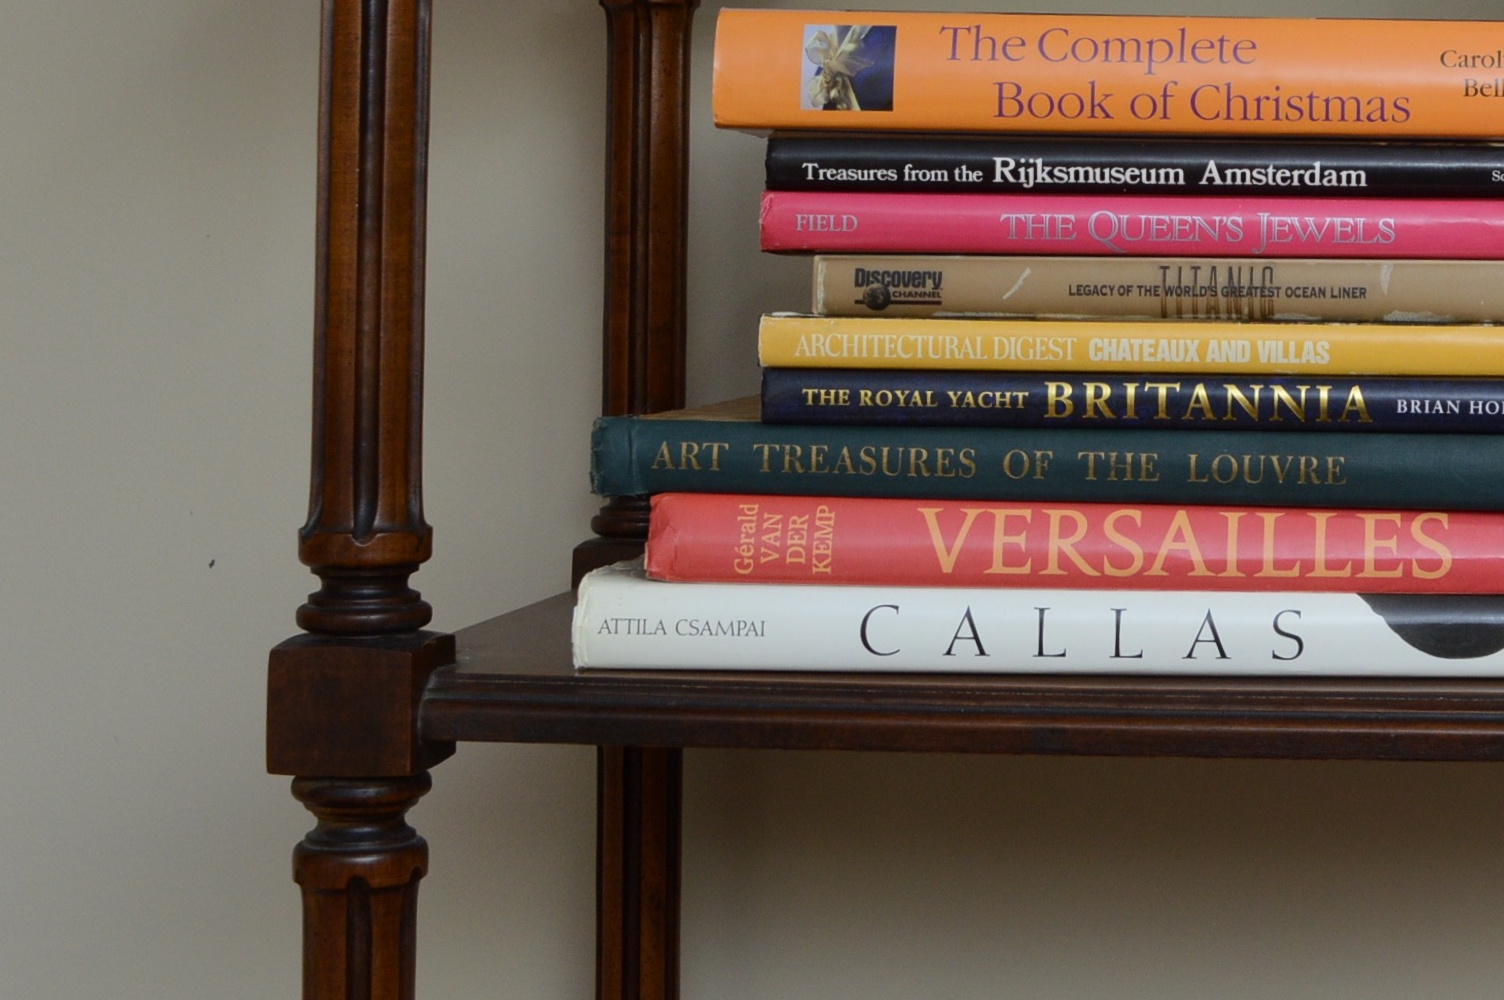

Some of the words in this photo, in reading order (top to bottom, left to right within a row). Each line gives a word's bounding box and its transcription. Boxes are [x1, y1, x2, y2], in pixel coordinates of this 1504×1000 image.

[940, 26, 1026, 62] The
[1037, 27, 1257, 75] Complete
[993, 81, 1114, 120] Book
[1130, 81, 1178, 121] of
[1190, 83, 1411, 123] Christmas
[802, 163, 898, 182] Treasures
[903, 165, 949, 183] from
[953, 166, 984, 183] the
[992, 157, 1185, 188] Rijksmuseum
[1199, 160, 1368, 188] Amsterdam
[795, 213, 858, 233] FIELD
[1001, 213, 1077, 241] THE
[1088, 210, 1243, 253] QUEEN'S
[1254, 211, 1396, 252] JEWELS
[892, 290, 943, 299] CHANNEL
[1068, 283, 1114, 297] LEGACY
[1117, 284, 1133, 297] OF
[1136, 284, 1160, 298] THE
[1165, 285, 1218, 298] WORLD'S
[1221, 286, 1282, 299] GREATEST
[1285, 286, 1328, 299] OCEAN
[1330, 286, 1367, 299] LINER
[1160, 265, 1275, 319] TITANIC
[795, 334, 987, 360] ARCHITECTURAL
[993, 337, 1077, 361] DIGEST
[1089, 337, 1200, 363] CHATEAUX
[1206, 339, 1251, 363] AND
[1257, 340, 1330, 364] VILLAS
[802, 388, 850, 407] THE
[859, 389, 938, 408] ROYAL
[947, 391, 1029, 410] YACHT
[1044, 380, 1373, 424] BRITANNIA
[1396, 399, 1461, 415] BRIAN
[652, 441, 729, 471] ART
[753, 443, 977, 478] TREASURES
[1003, 449, 1053, 479] OF
[1078, 451, 1160, 482] THE
[1187, 453, 1347, 485] LOUVRE
[733, 502, 760, 575] Gérald
[760, 512, 783, 564] VAN
[786, 514, 809, 565] DER
[813, 504, 837, 574] KEMP
[917, 507, 1453, 579] VERSAILLES
[598, 618, 668, 636] ATTILA
[675, 618, 766, 637] CSAMPAI
[860, 604, 1305, 661] CALLAS
